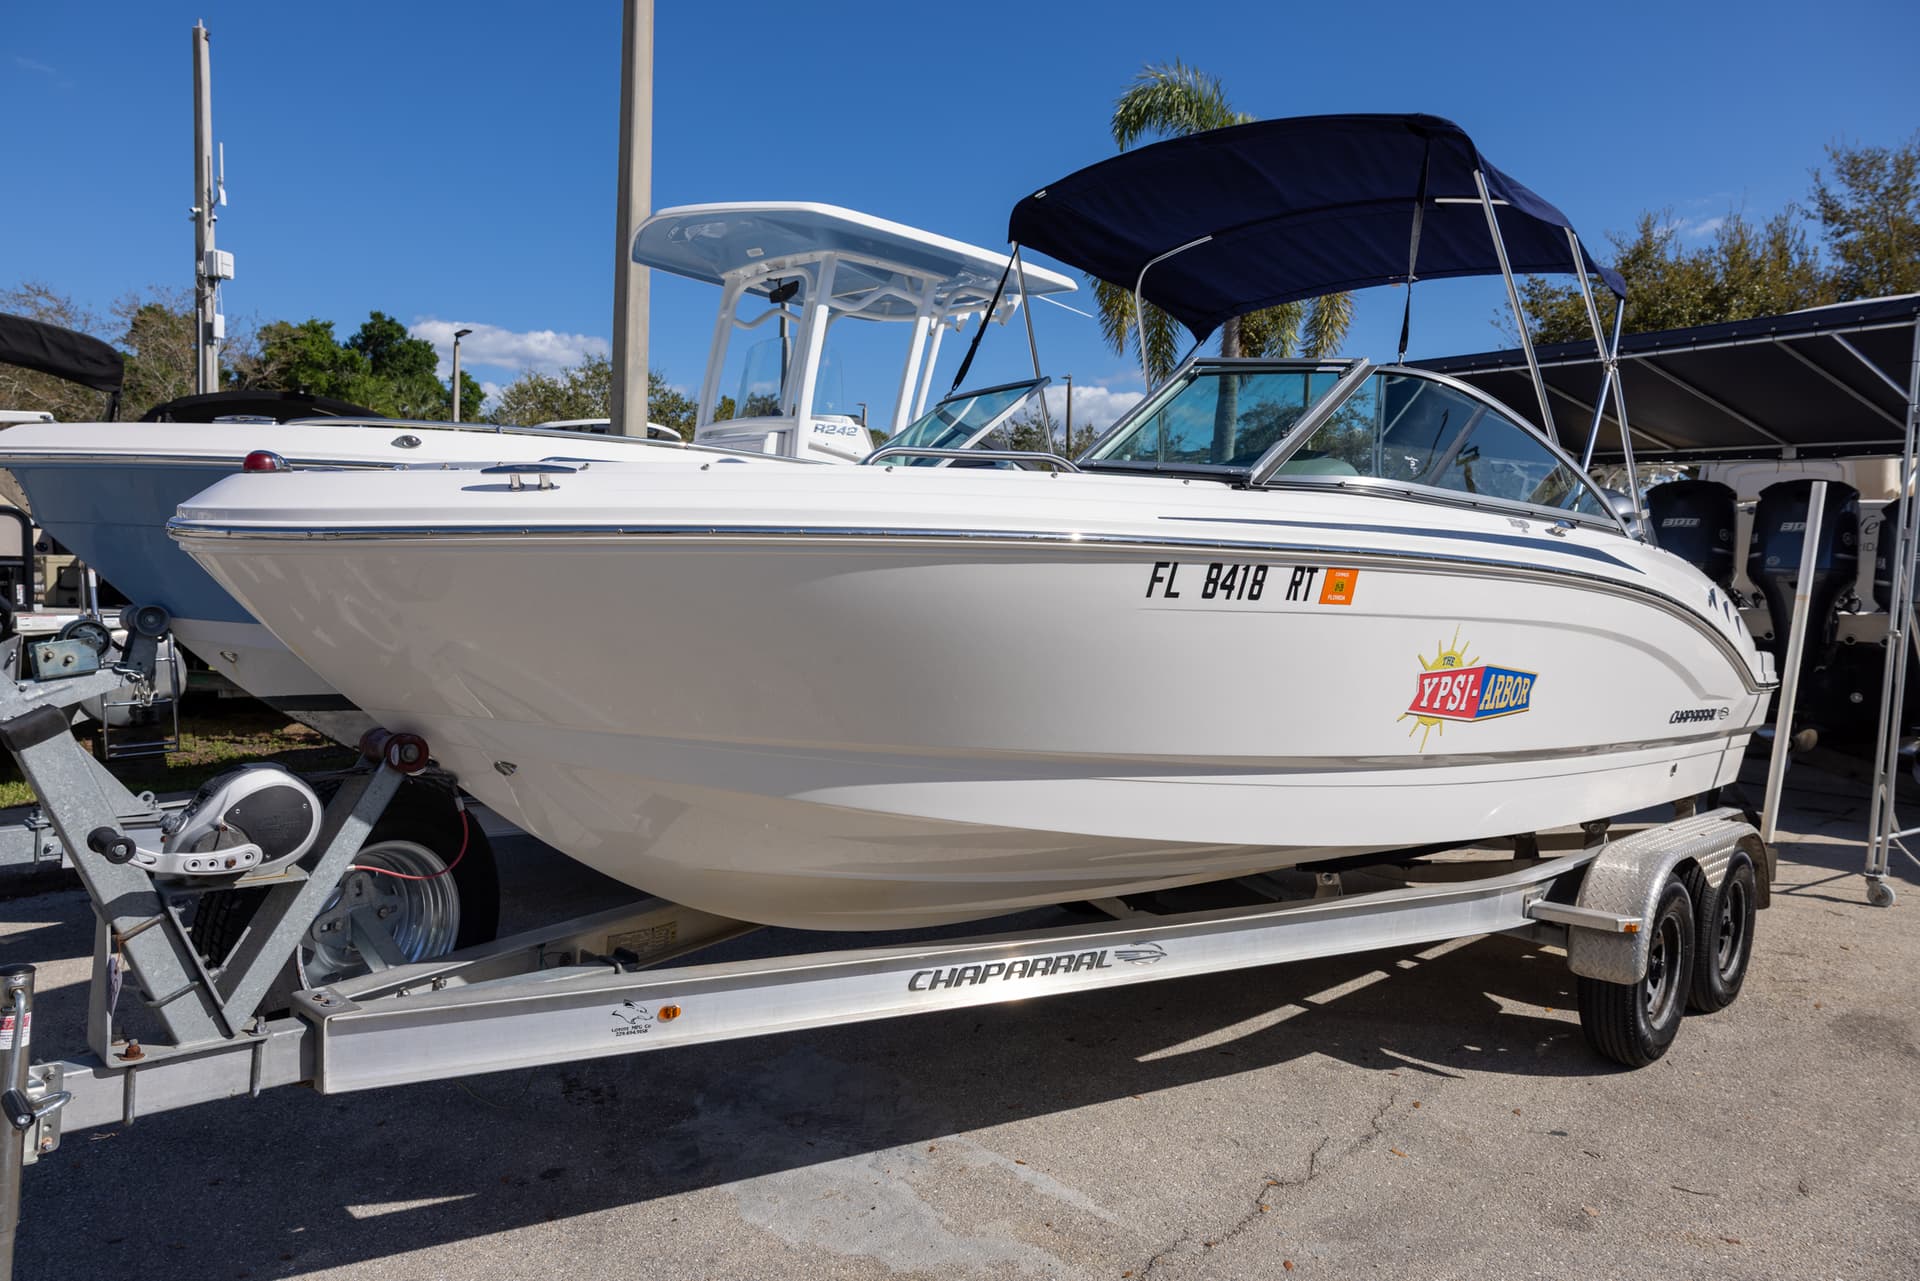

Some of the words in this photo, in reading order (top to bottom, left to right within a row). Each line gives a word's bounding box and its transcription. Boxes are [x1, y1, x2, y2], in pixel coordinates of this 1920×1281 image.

[813, 423, 858, 437] R242
[1780, 521, 1807, 533] 30
[1145, 561, 1180, 599] FL
[1201, 562, 1269, 601] 8418
[1285, 565, 1319, 602] RT
[1442, 656, 1456, 667] THE
[907, 949, 1113, 993] CHAPARRAL
